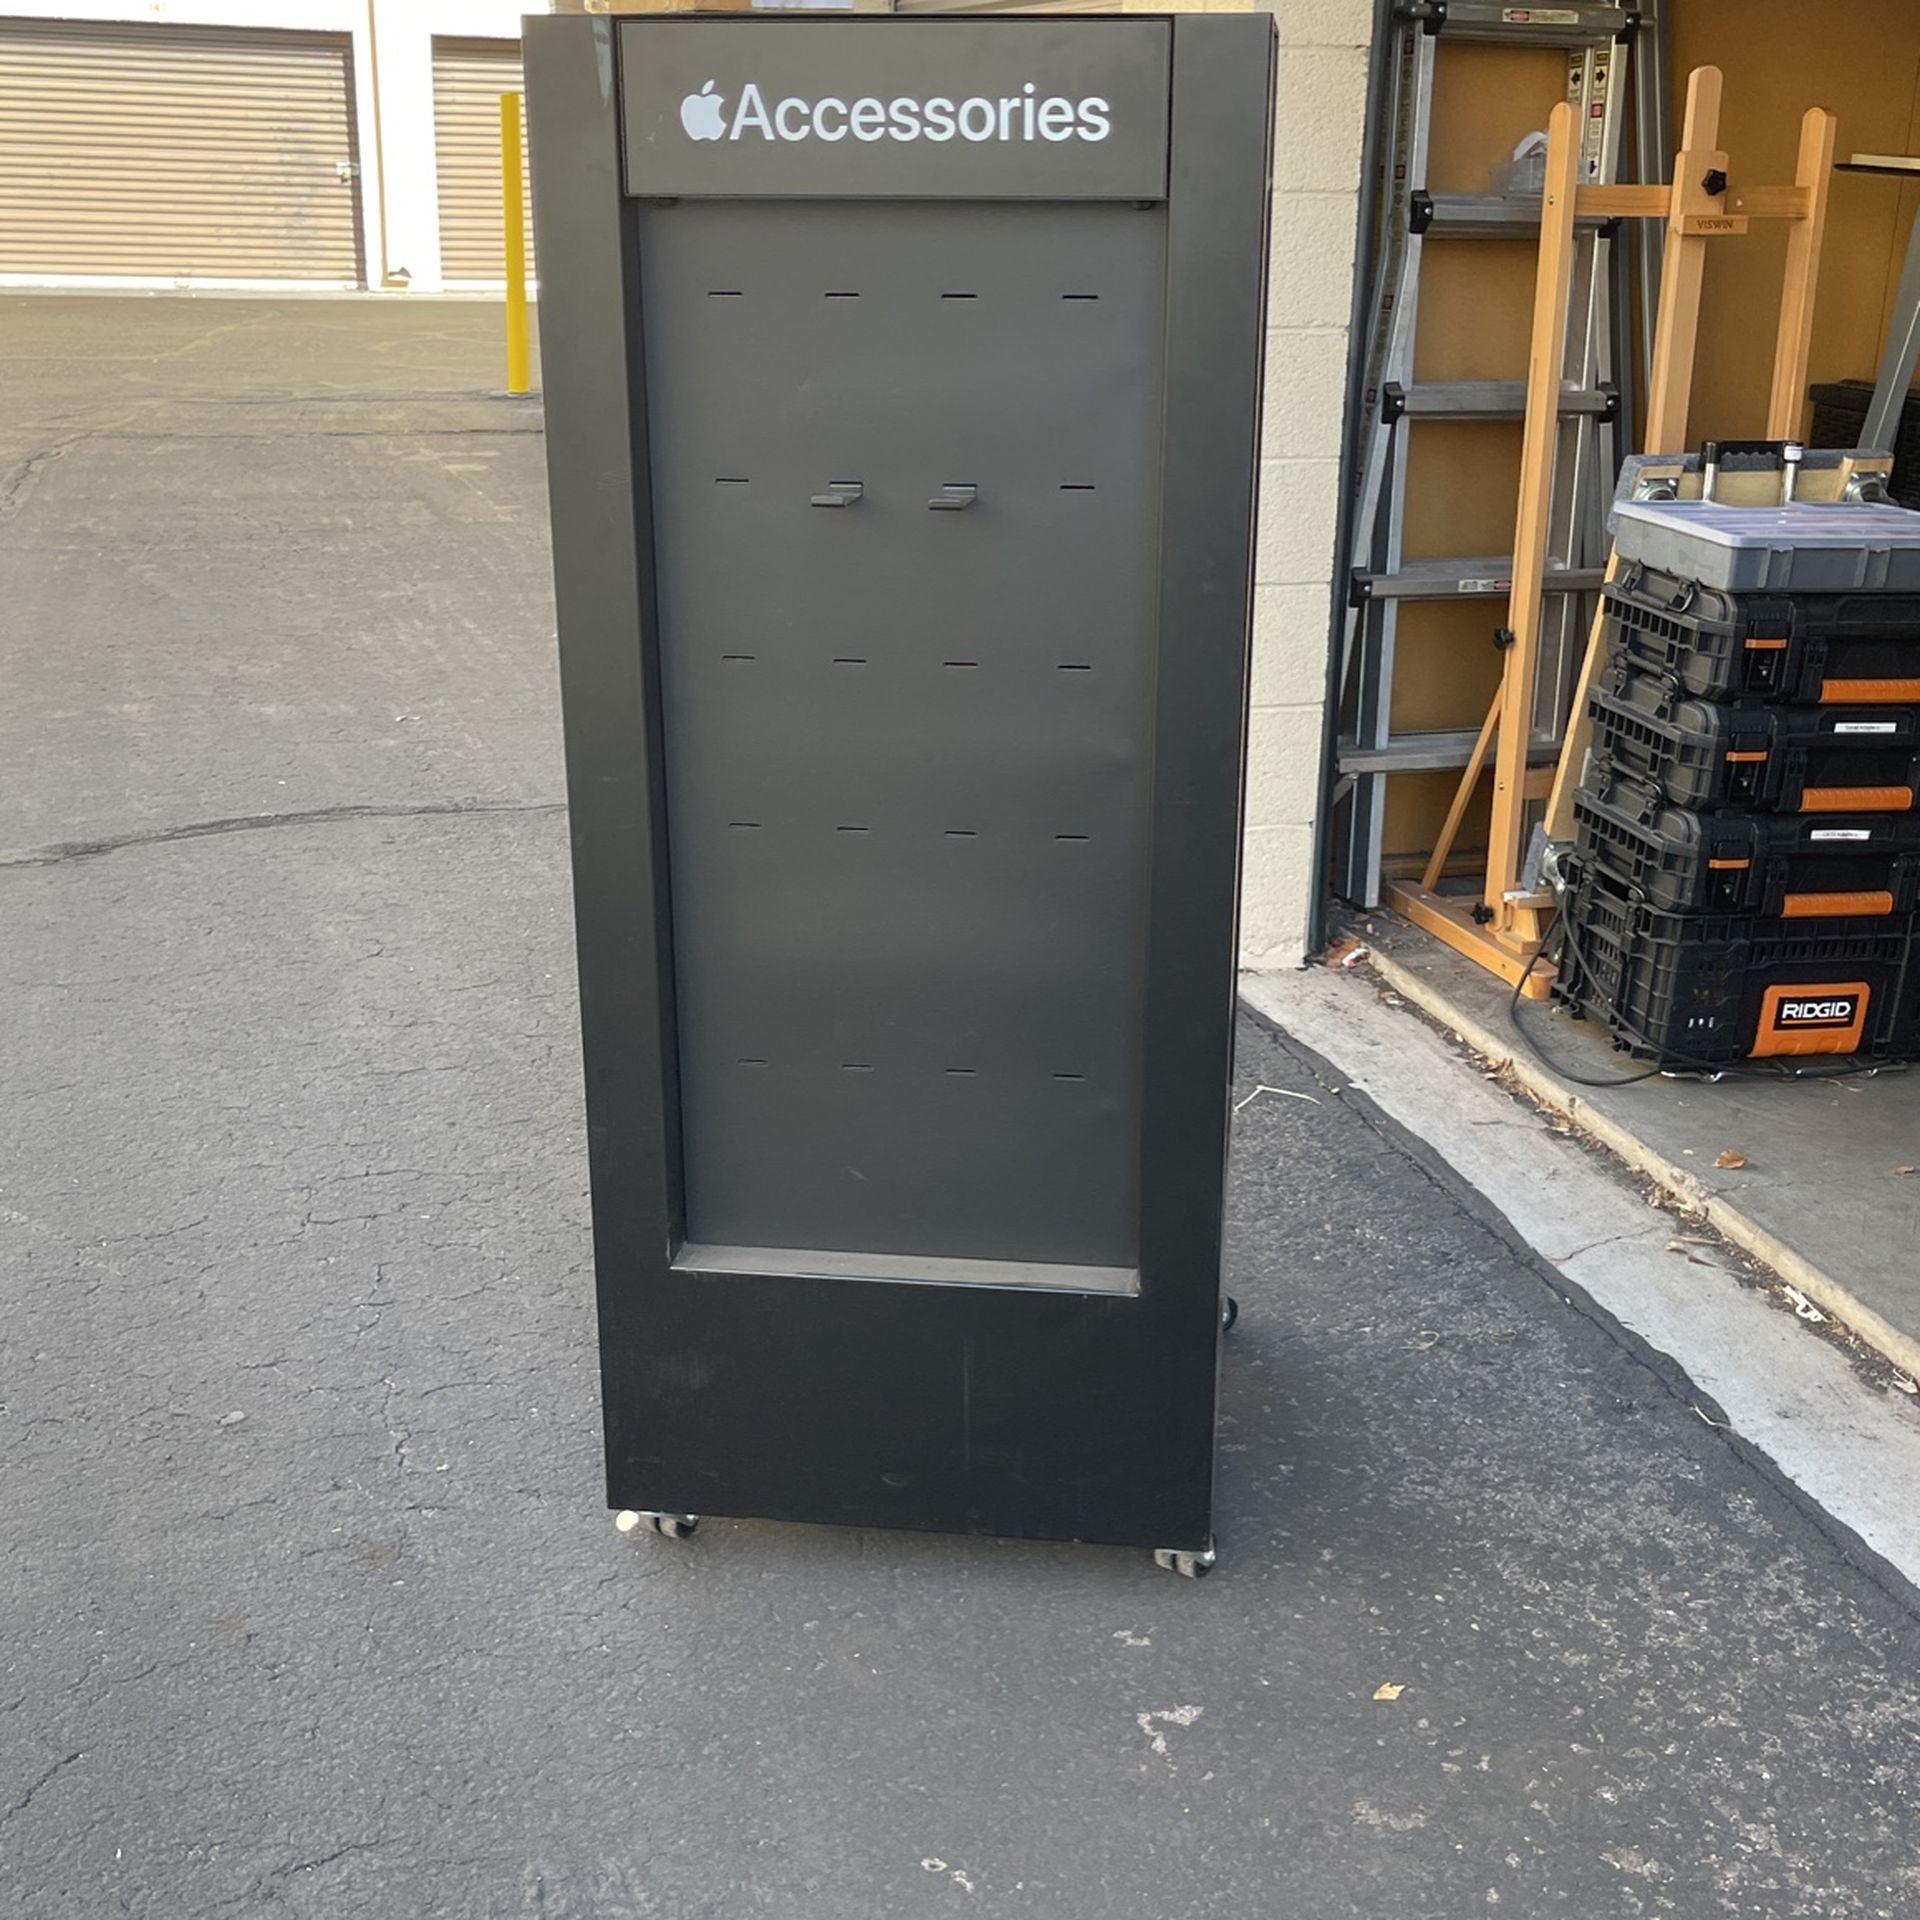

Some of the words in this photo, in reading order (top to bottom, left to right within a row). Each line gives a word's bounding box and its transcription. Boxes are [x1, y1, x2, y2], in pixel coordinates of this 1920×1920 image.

[729, 82, 1111, 143] Accessories
[1696, 219, 1734, 230] VISWIN
[1781, 1001, 1852, 1020] RIDGID
